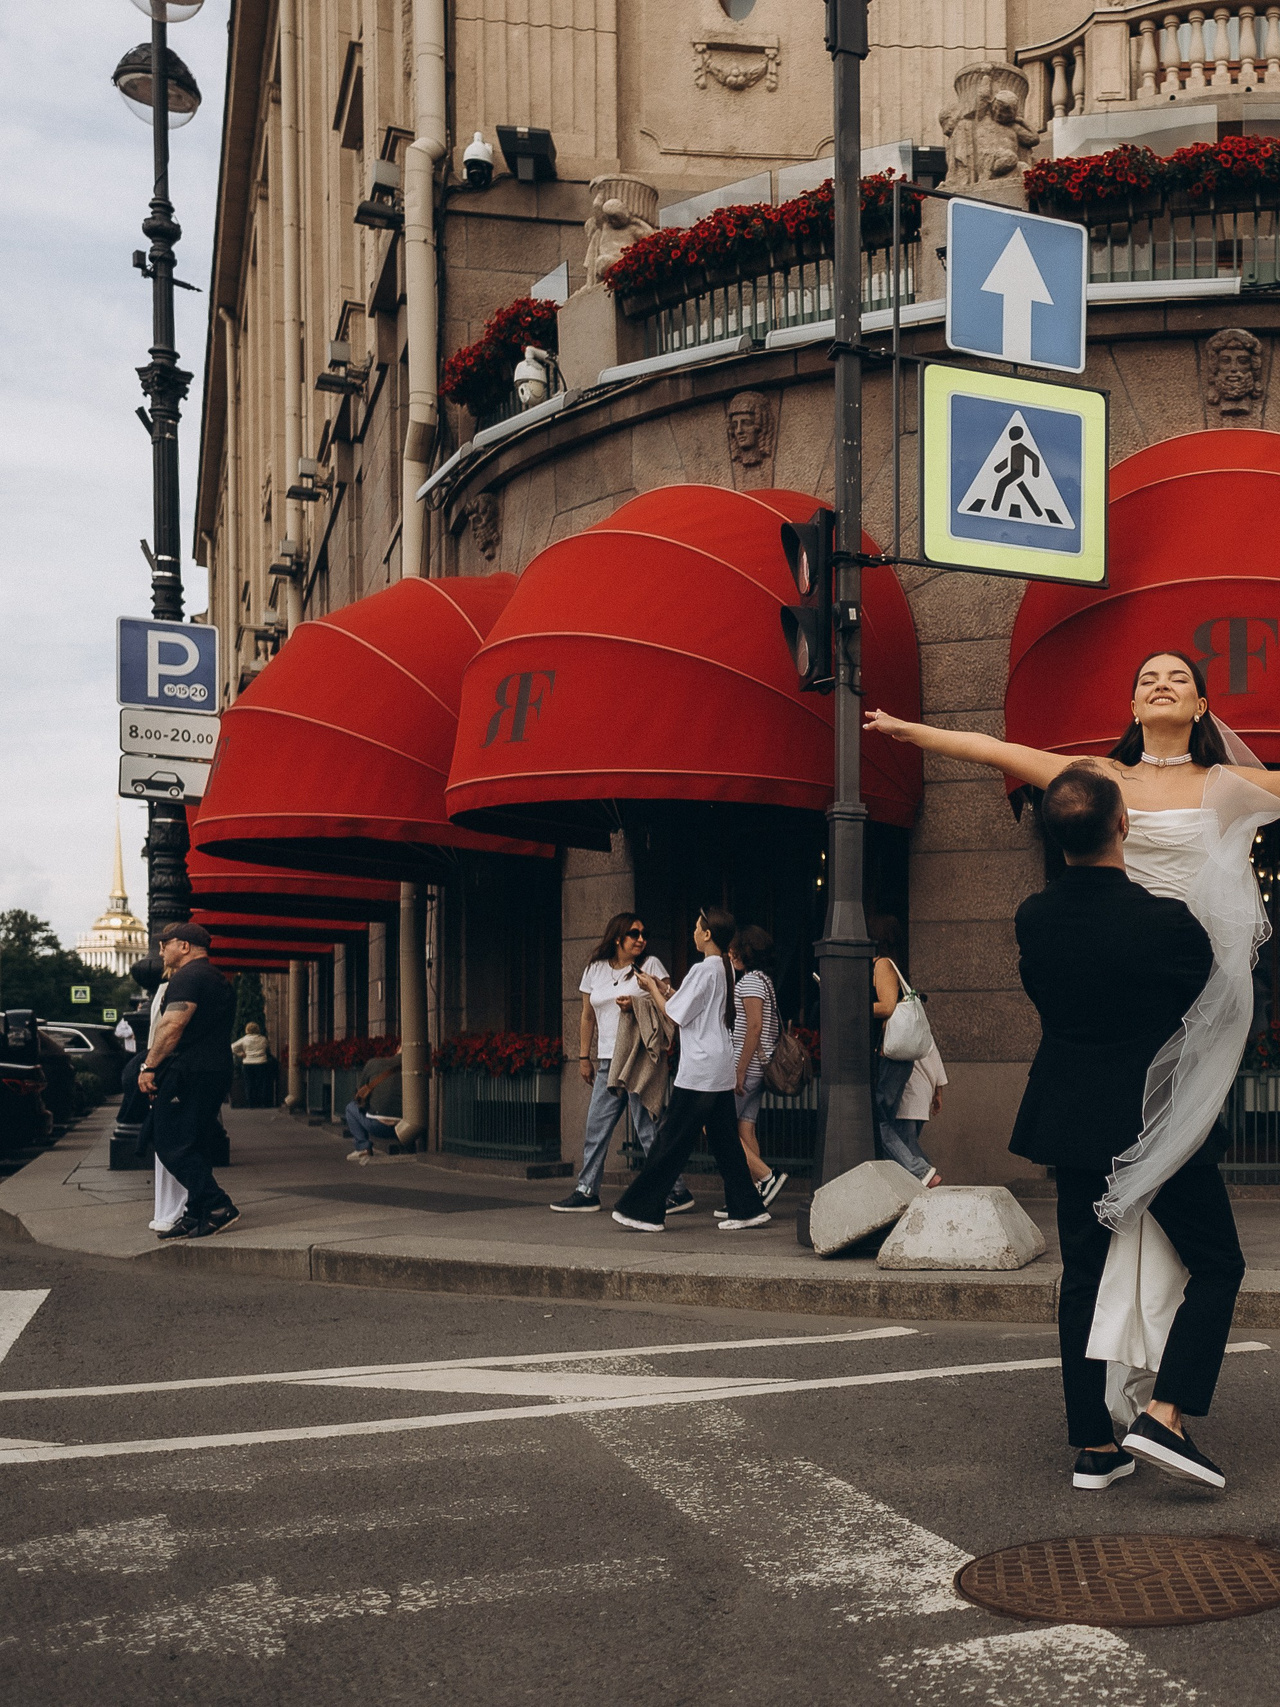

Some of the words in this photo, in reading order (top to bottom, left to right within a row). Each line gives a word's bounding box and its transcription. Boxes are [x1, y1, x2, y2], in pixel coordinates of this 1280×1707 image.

[147, 629, 200, 698] P
[191, 686, 207, 698] 20
[128, 724, 214, 745] 8.00-20.00
